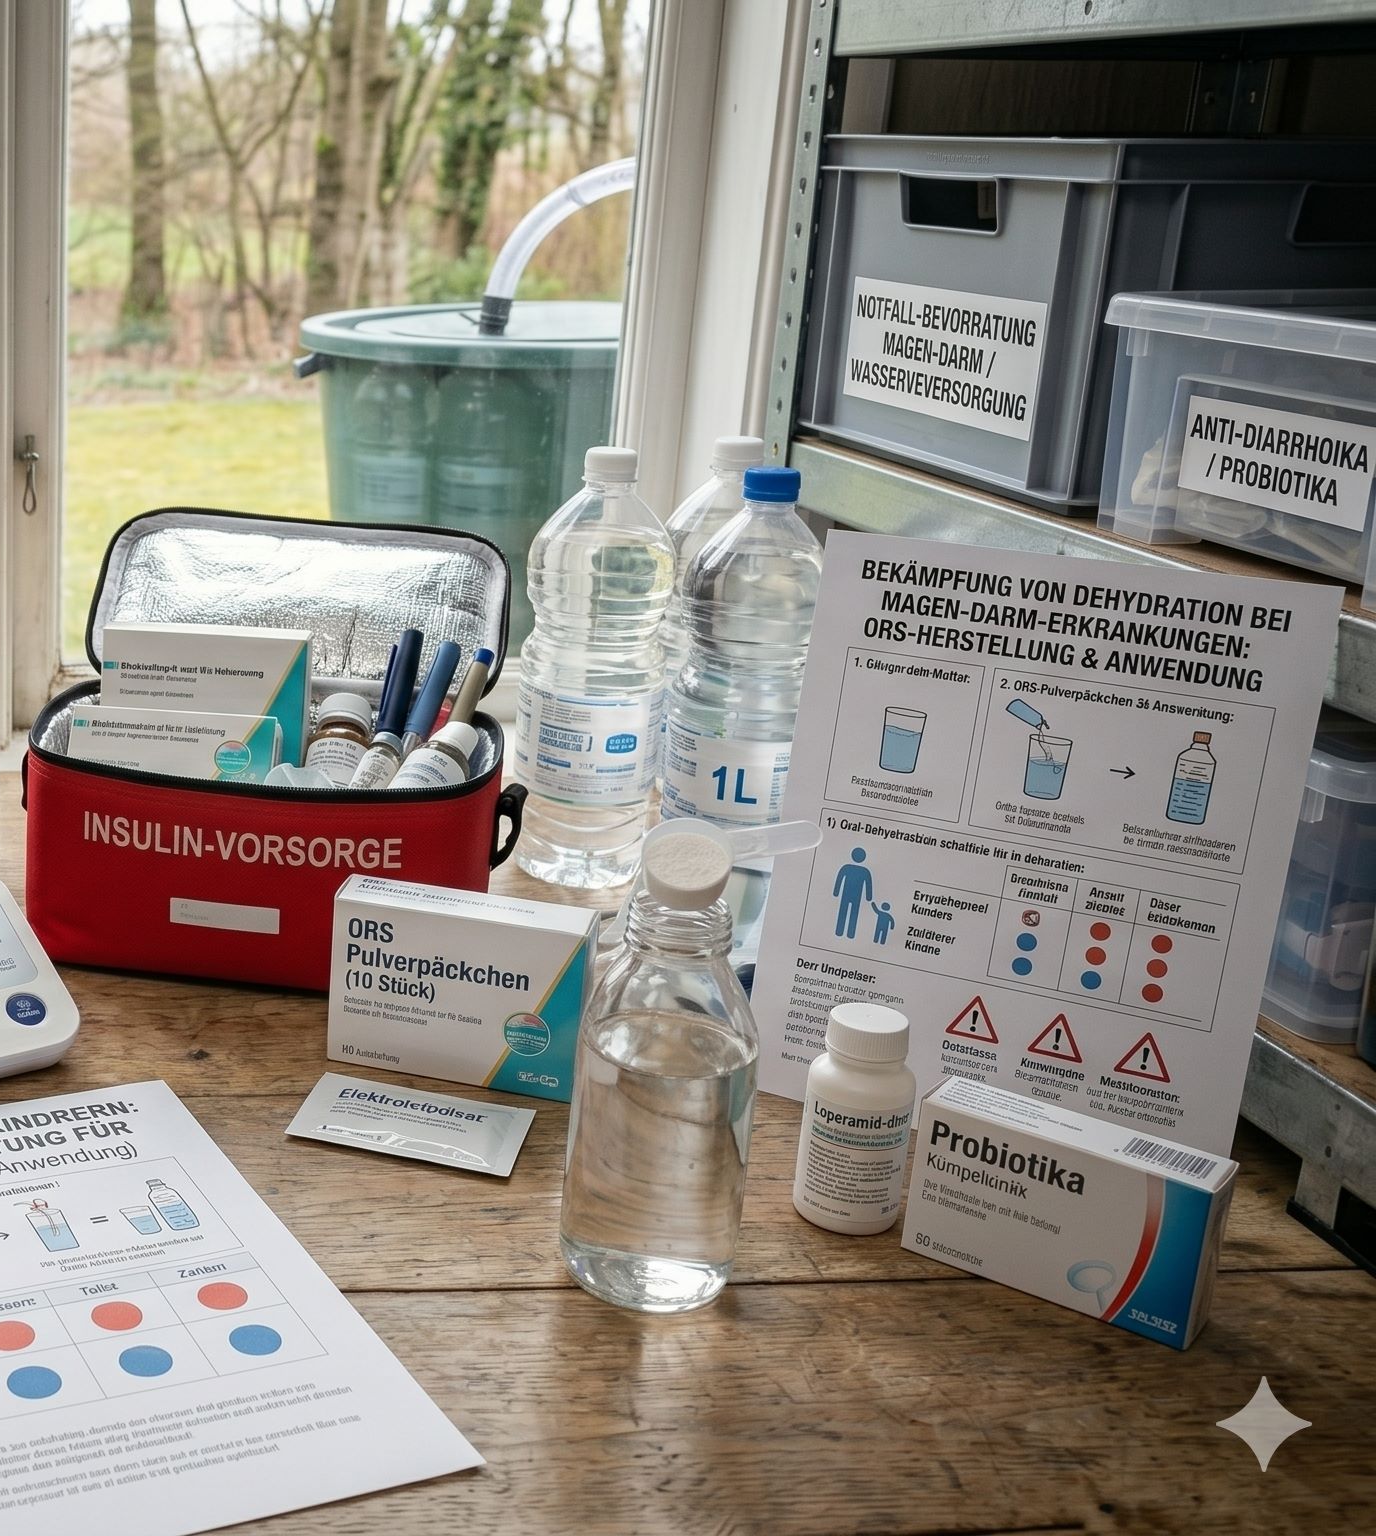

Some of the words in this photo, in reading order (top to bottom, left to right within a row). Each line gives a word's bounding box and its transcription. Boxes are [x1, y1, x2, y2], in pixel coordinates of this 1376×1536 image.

[857, 294, 1036, 347] NOTFALL-BEVORRATUNG
[882, 331, 984, 375] MAGEN-DARM
[985, 351, 997, 379] /
[851, 358, 1027, 422] WASSERVEVERSORGUNG
[1190, 413, 1368, 473] ANTI-DIARRHOIKA
[1205, 453, 1217, 478] /
[1219, 455, 1338, 507] PROBIOTIKA
[861, 559, 1013, 597] BEKÄMPFUNG
[1020, 577, 1065, 605] VON
[1073, 583, 1244, 626] DEHYDRATION
[1250, 607, 1292, 633] BEI
[880, 590, 1251, 660] MAGEN-DARM-ERKRANKUNGEN:
[863, 616, 1075, 667] ORS-HERSTELLUNG
[1080, 646, 1098, 670] &
[1104, 651, 1264, 693] ANWENDUNG
[999, 678, 1011, 690] 2.
[1013, 679, 1133, 708] ORS-Pulverpäckchen
[711, 765, 758, 805] 1L
[83, 811, 403, 869] INSULIN-VORSORGE
[1010, 849, 1022, 862] in
[347, 917, 395, 943] ORS
[345, 969, 373, 991] (10
[378, 972, 436, 1004] Stück)
[346, 943, 530, 991] Pulverpäckchen
[72, 1120, 134, 1142] FÜR
[930, 1119, 1086, 1196] Probiotika
